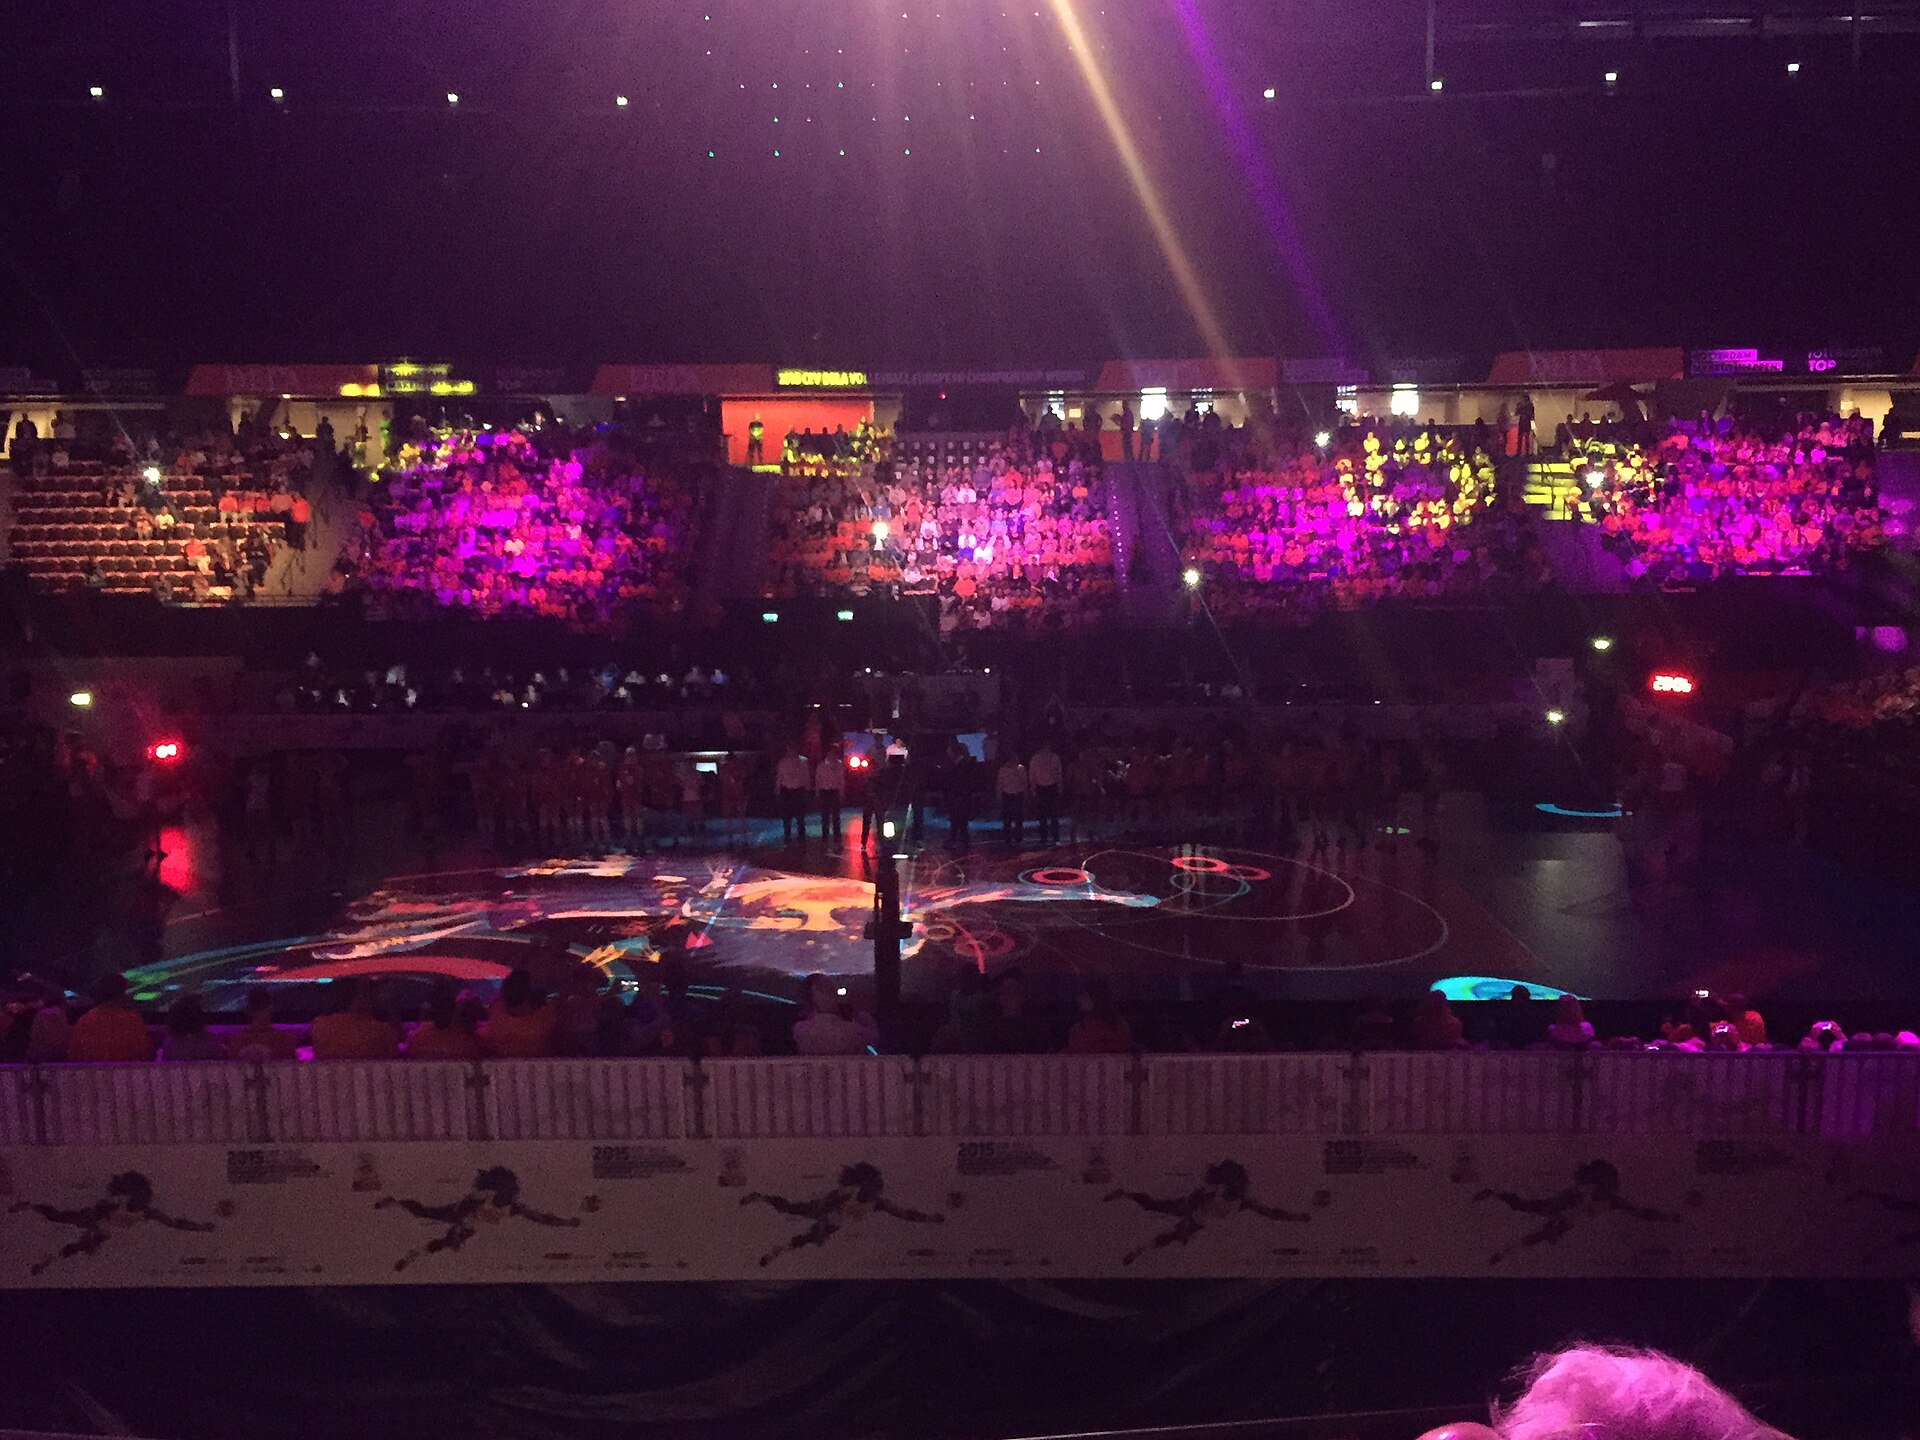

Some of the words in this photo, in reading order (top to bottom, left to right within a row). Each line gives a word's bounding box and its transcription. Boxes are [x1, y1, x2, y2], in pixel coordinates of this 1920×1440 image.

[593, 1146, 630, 1161] 2015
[958, 1142, 995, 1158] 2015
[227, 1151, 265, 1166] 2015
